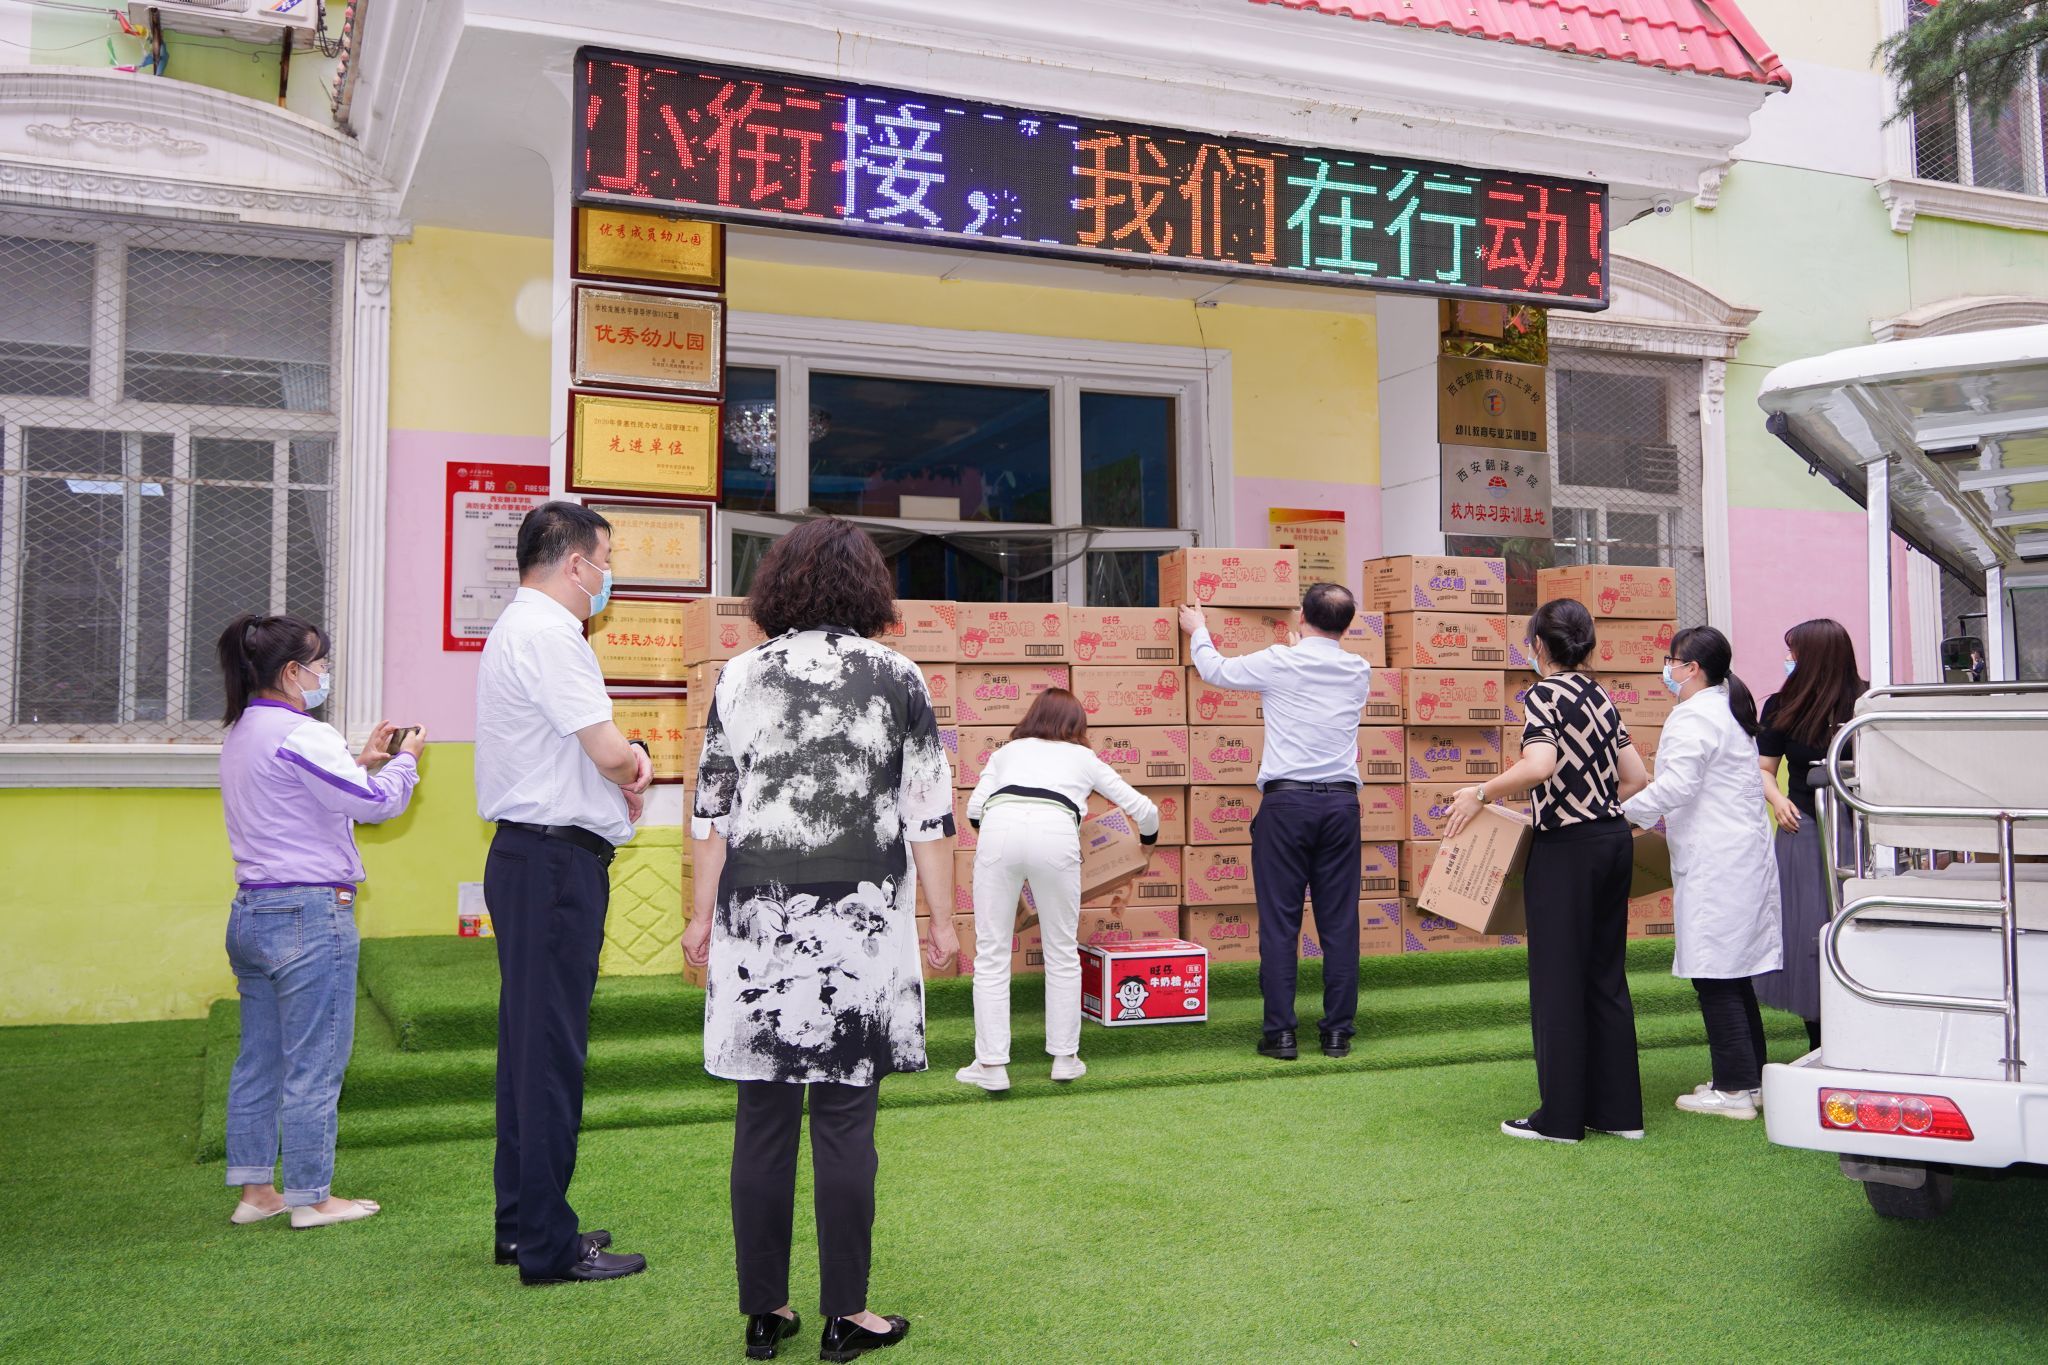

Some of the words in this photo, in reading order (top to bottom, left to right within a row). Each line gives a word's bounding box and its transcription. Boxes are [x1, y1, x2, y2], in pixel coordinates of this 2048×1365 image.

[599, 223, 702, 246] 优秀成员幼儿园
[594, 324, 704, 351] 优秀幼儿园
[1446, 368, 1541, 405] 西安旅游教育技工学校
[1455, 424, 1537, 442] 幼儿教育专业实训基地
[608, 434, 685, 456] 先进单位
[1456, 458, 1539, 489] 西安翻译学院
[469, 479, 496, 491] 消防
[524, 484, 538, 492] FIRE
[1450, 500, 1546, 526] 校内实习实训基地
[1222, 557, 1240, 566] 旺仔
[1221, 567, 1267, 583] 牛奶糖
[1620, 574, 1633, 582] 旺仔
[988, 611, 1008, 621] 旺仔
[1102, 616, 1121, 624] 旺仔
[1224, 617, 1241, 626] 旺仔
[988, 621, 1036, 637] 牛奶糖
[1102, 625, 1147, 641] 牛奶糖
[1445, 625, 1459, 633] 旺仔
[1440, 678, 1456, 686] 旺仔
[1439, 739, 1453, 747] 旺仔
[1228, 799, 1243, 807] 旺仔
[1222, 857, 1238, 865] 旺仔
[1226, 915, 1240, 923] 旺仔
[1106, 922, 1121, 930] 旺仔
[1150, 964, 1173, 976] 旺仔
[1150, 976, 1182, 988] 牛奶糖
